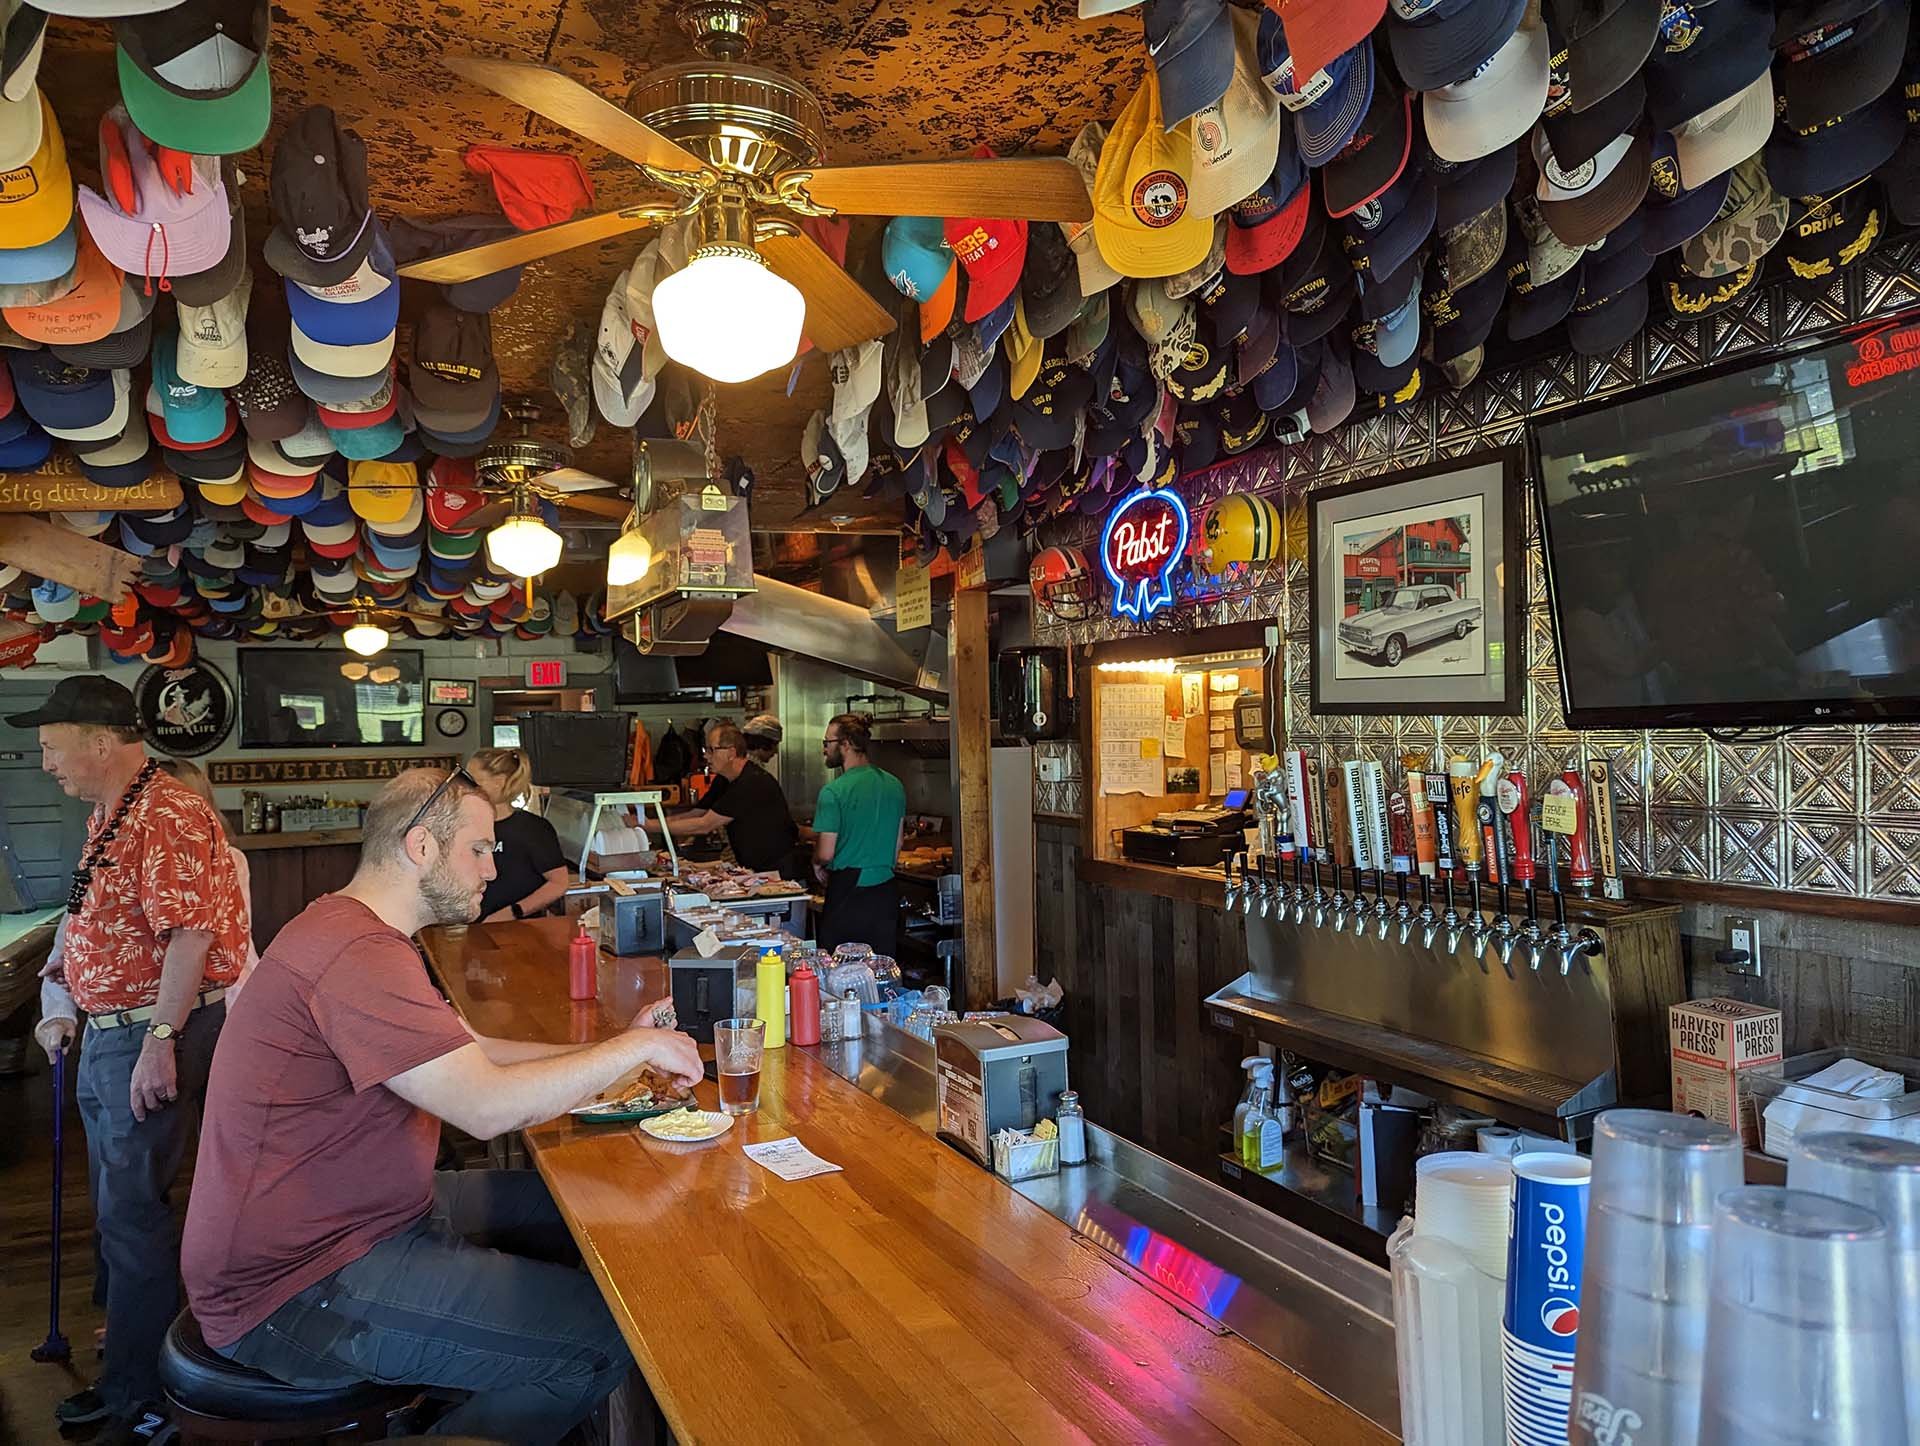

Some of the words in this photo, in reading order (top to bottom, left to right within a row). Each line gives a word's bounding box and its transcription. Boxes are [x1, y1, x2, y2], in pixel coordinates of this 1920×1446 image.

[1308, 79, 1328, 97] SYSTEM
[1149, 183, 1167, 192] SWAT
[1800, 212, 1845, 238] DRIVE
[27, 311, 60, 323] RUNE
[167, 384, 198, 397] YAS
[1113, 512, 1173, 571] Pabst
[531, 661, 561, 686] EXIT
[157, 726, 183, 735] HIGH
[193, 724, 217, 733] LIFE
[213, 761, 347, 781] HELVETIA
[1286, 757, 1297, 793] ULTRA
[1350, 767, 1359, 777] 10
[1374, 769, 1382, 778] 10
[1351, 778, 1363, 811] BARREL
[1375, 779, 1386, 813] BARREL
[1428, 780, 1447, 796] PALE
[1355, 811, 1368, 850] BREWING
[1379, 813, 1389, 851] BREWING
[1598, 787, 1612, 874] BREAKSIDE
[1487, 835, 1498, 874] KIWANDA
[1671, 1011, 1725, 1041] HARVEST
[1736, 1017, 1779, 1043] HARVEST
[1680, 1030, 1716, 1056] PRESS
[1745, 1035, 1774, 1058] PRESS
[1540, 1202, 1576, 1292] pepsi
